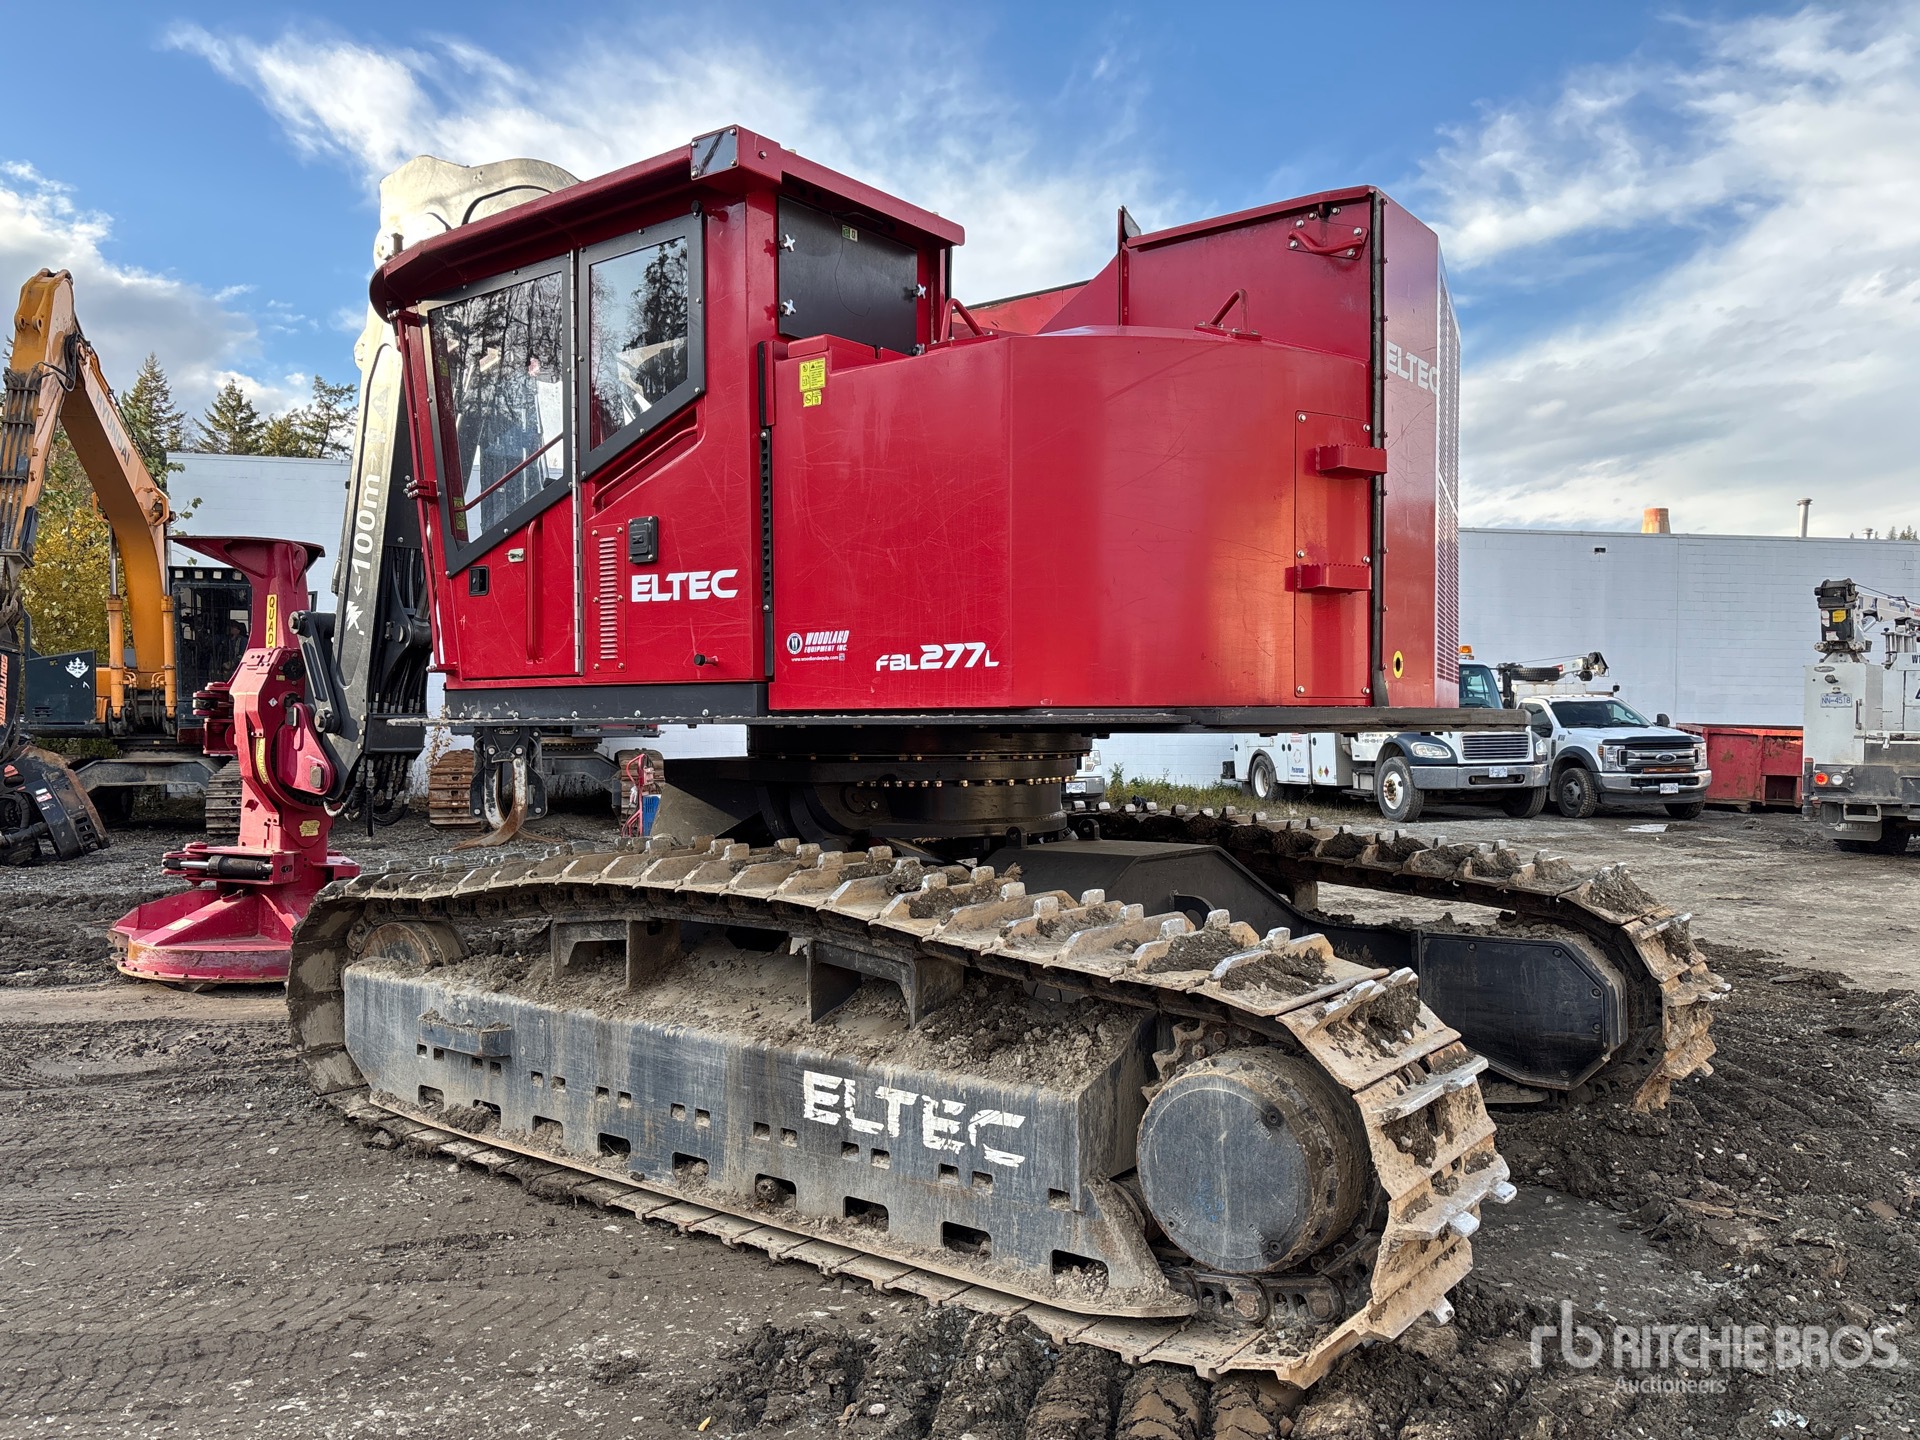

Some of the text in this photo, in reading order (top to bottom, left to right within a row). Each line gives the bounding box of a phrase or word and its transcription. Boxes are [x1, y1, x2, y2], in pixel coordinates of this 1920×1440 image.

[1386, 340, 1438, 395] ELTEC
[96, 389, 130, 467] HYUNDAI
[631, 568, 738, 603] ELTEC
[267, 596, 276, 648] QUAD
[805, 630, 850, 646] WOODLAND
[803, 1070, 1026, 1168] ELTEC
